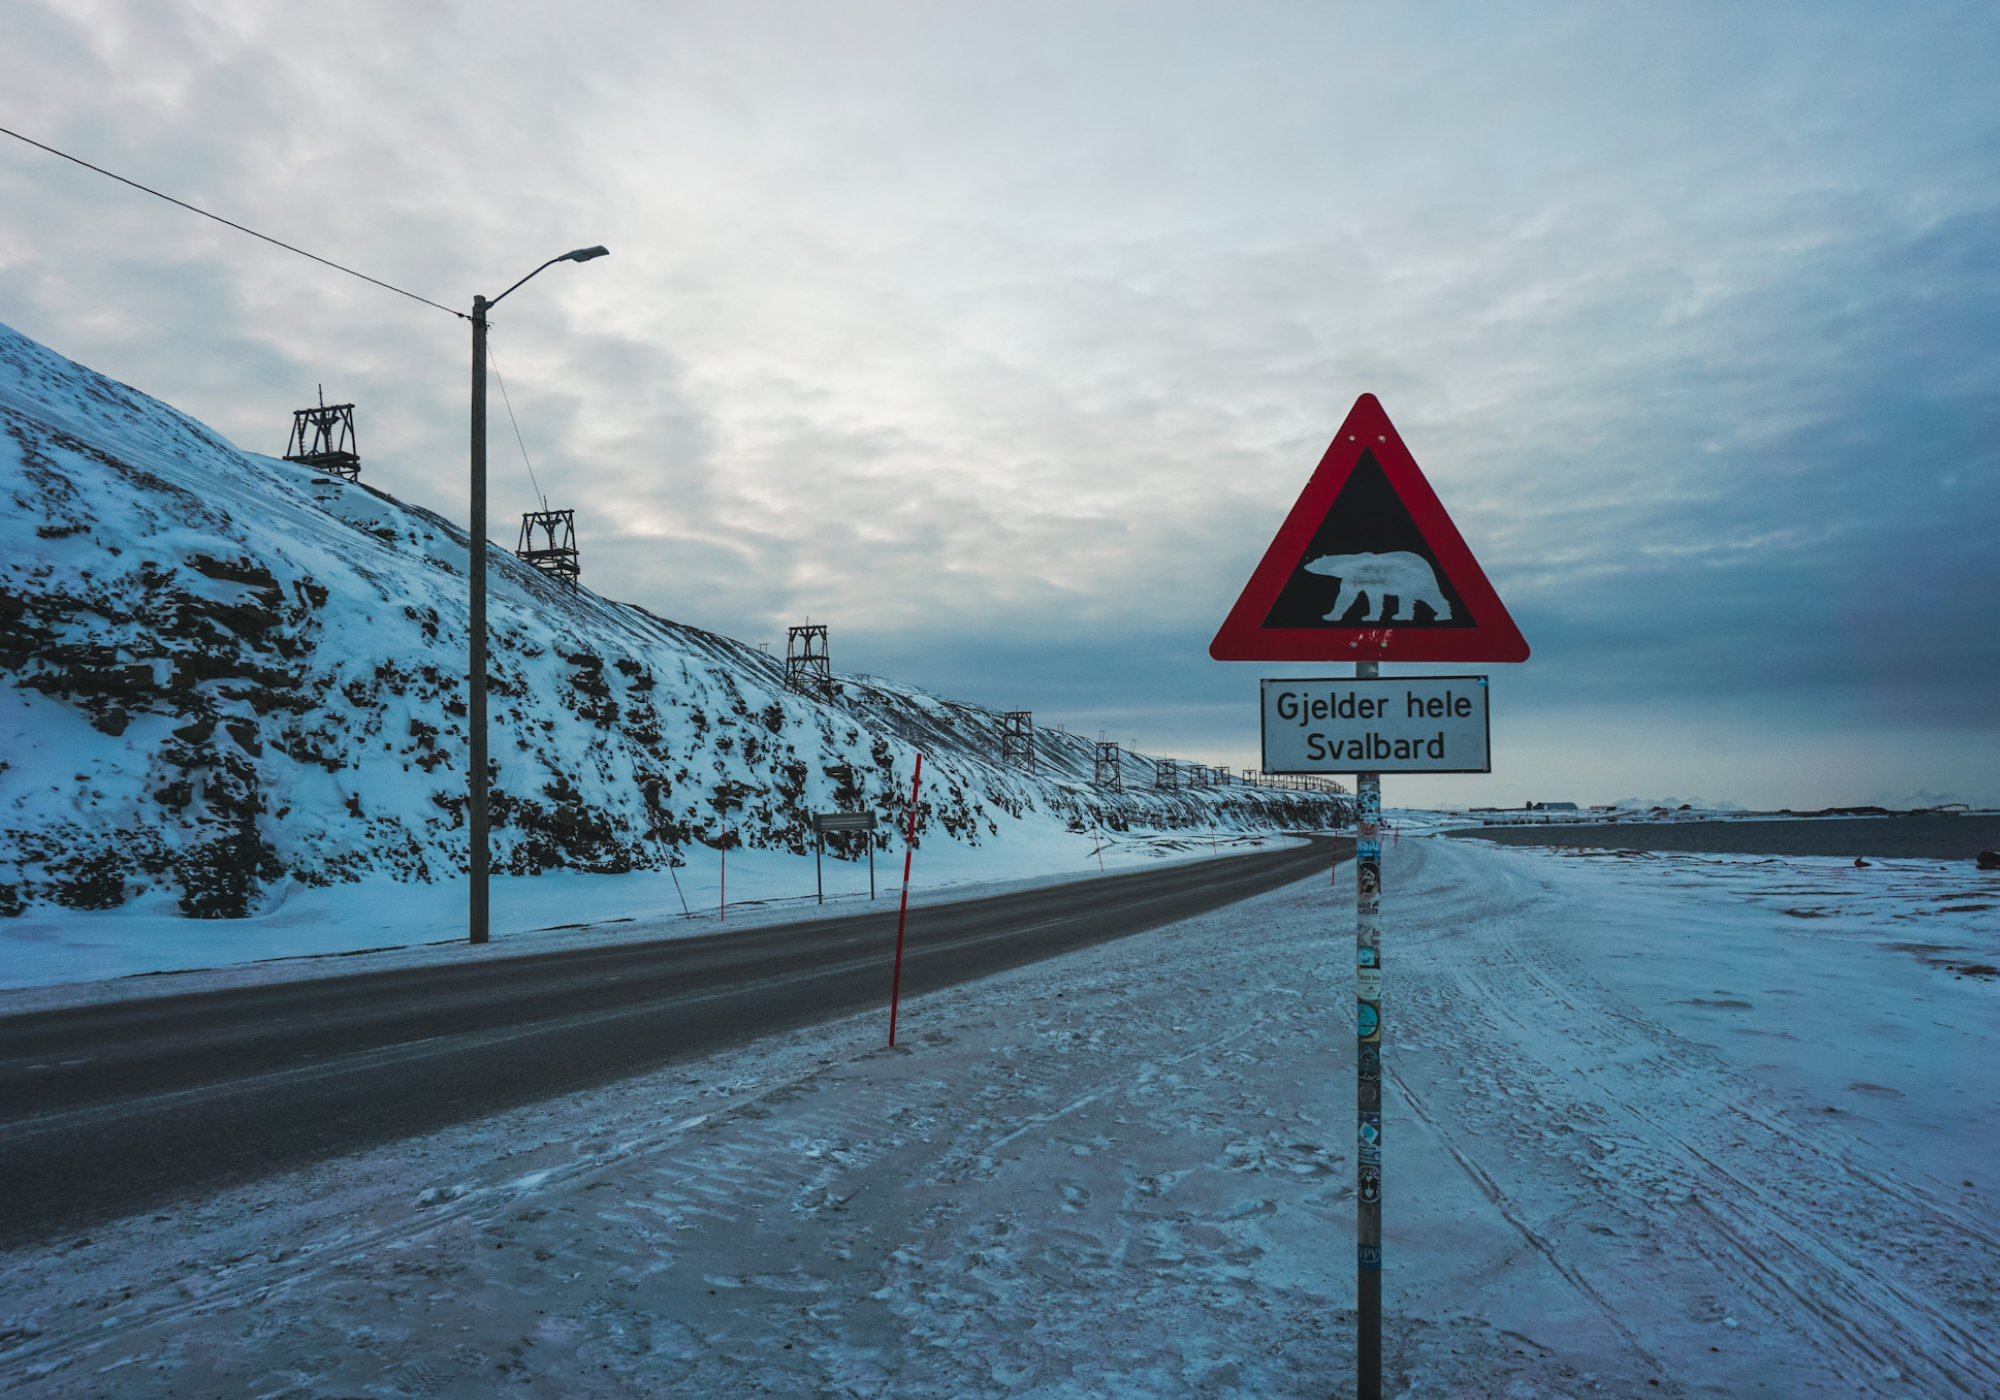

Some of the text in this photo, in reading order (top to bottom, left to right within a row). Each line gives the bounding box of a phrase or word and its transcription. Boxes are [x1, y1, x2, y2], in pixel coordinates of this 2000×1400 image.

[1277, 691, 1472, 727] Gjelder hele
[1307, 732, 1445, 760] Svalbard
